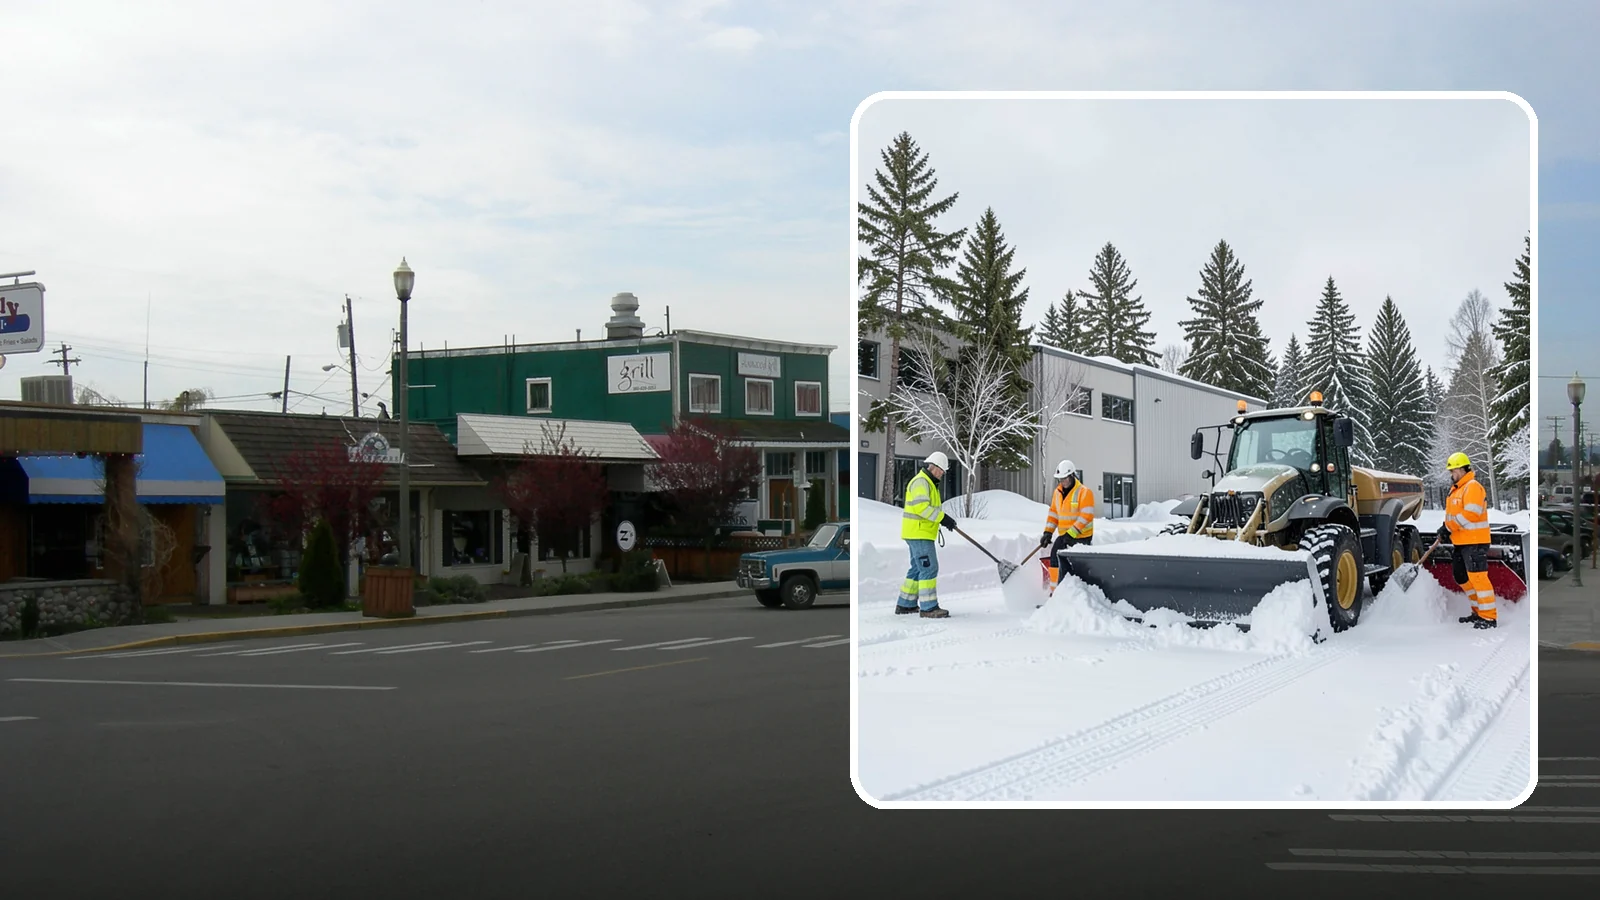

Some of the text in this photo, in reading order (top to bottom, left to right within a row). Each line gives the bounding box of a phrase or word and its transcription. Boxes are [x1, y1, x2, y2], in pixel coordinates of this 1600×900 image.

[0, 297, 19, 324] ly
[20, 337, 38, 345] Salads
[618, 355, 655, 391] grill
